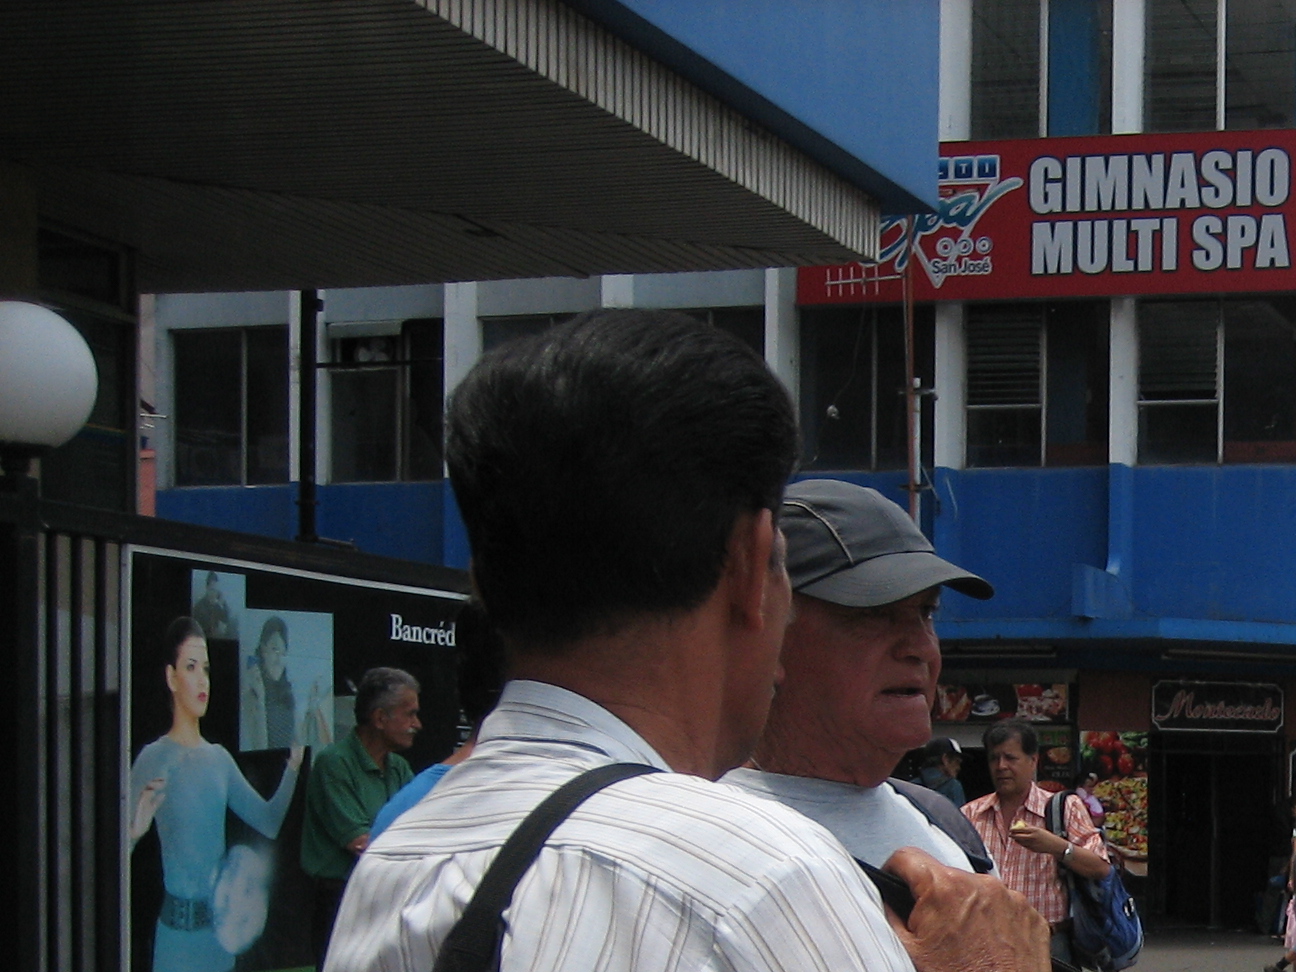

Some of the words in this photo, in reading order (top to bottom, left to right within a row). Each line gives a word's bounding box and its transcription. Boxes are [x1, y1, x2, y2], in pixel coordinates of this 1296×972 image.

[939, 162, 991, 176] TI
[1028, 148, 1290, 214] GIMNASIO
[1031, 217, 1178, 275] MULTI
[1192, 213, 1290, 271] SPA
[932, 260, 957, 274] San
[961, 257, 991, 274] José
[390, 613, 456, 646] Bancréd
